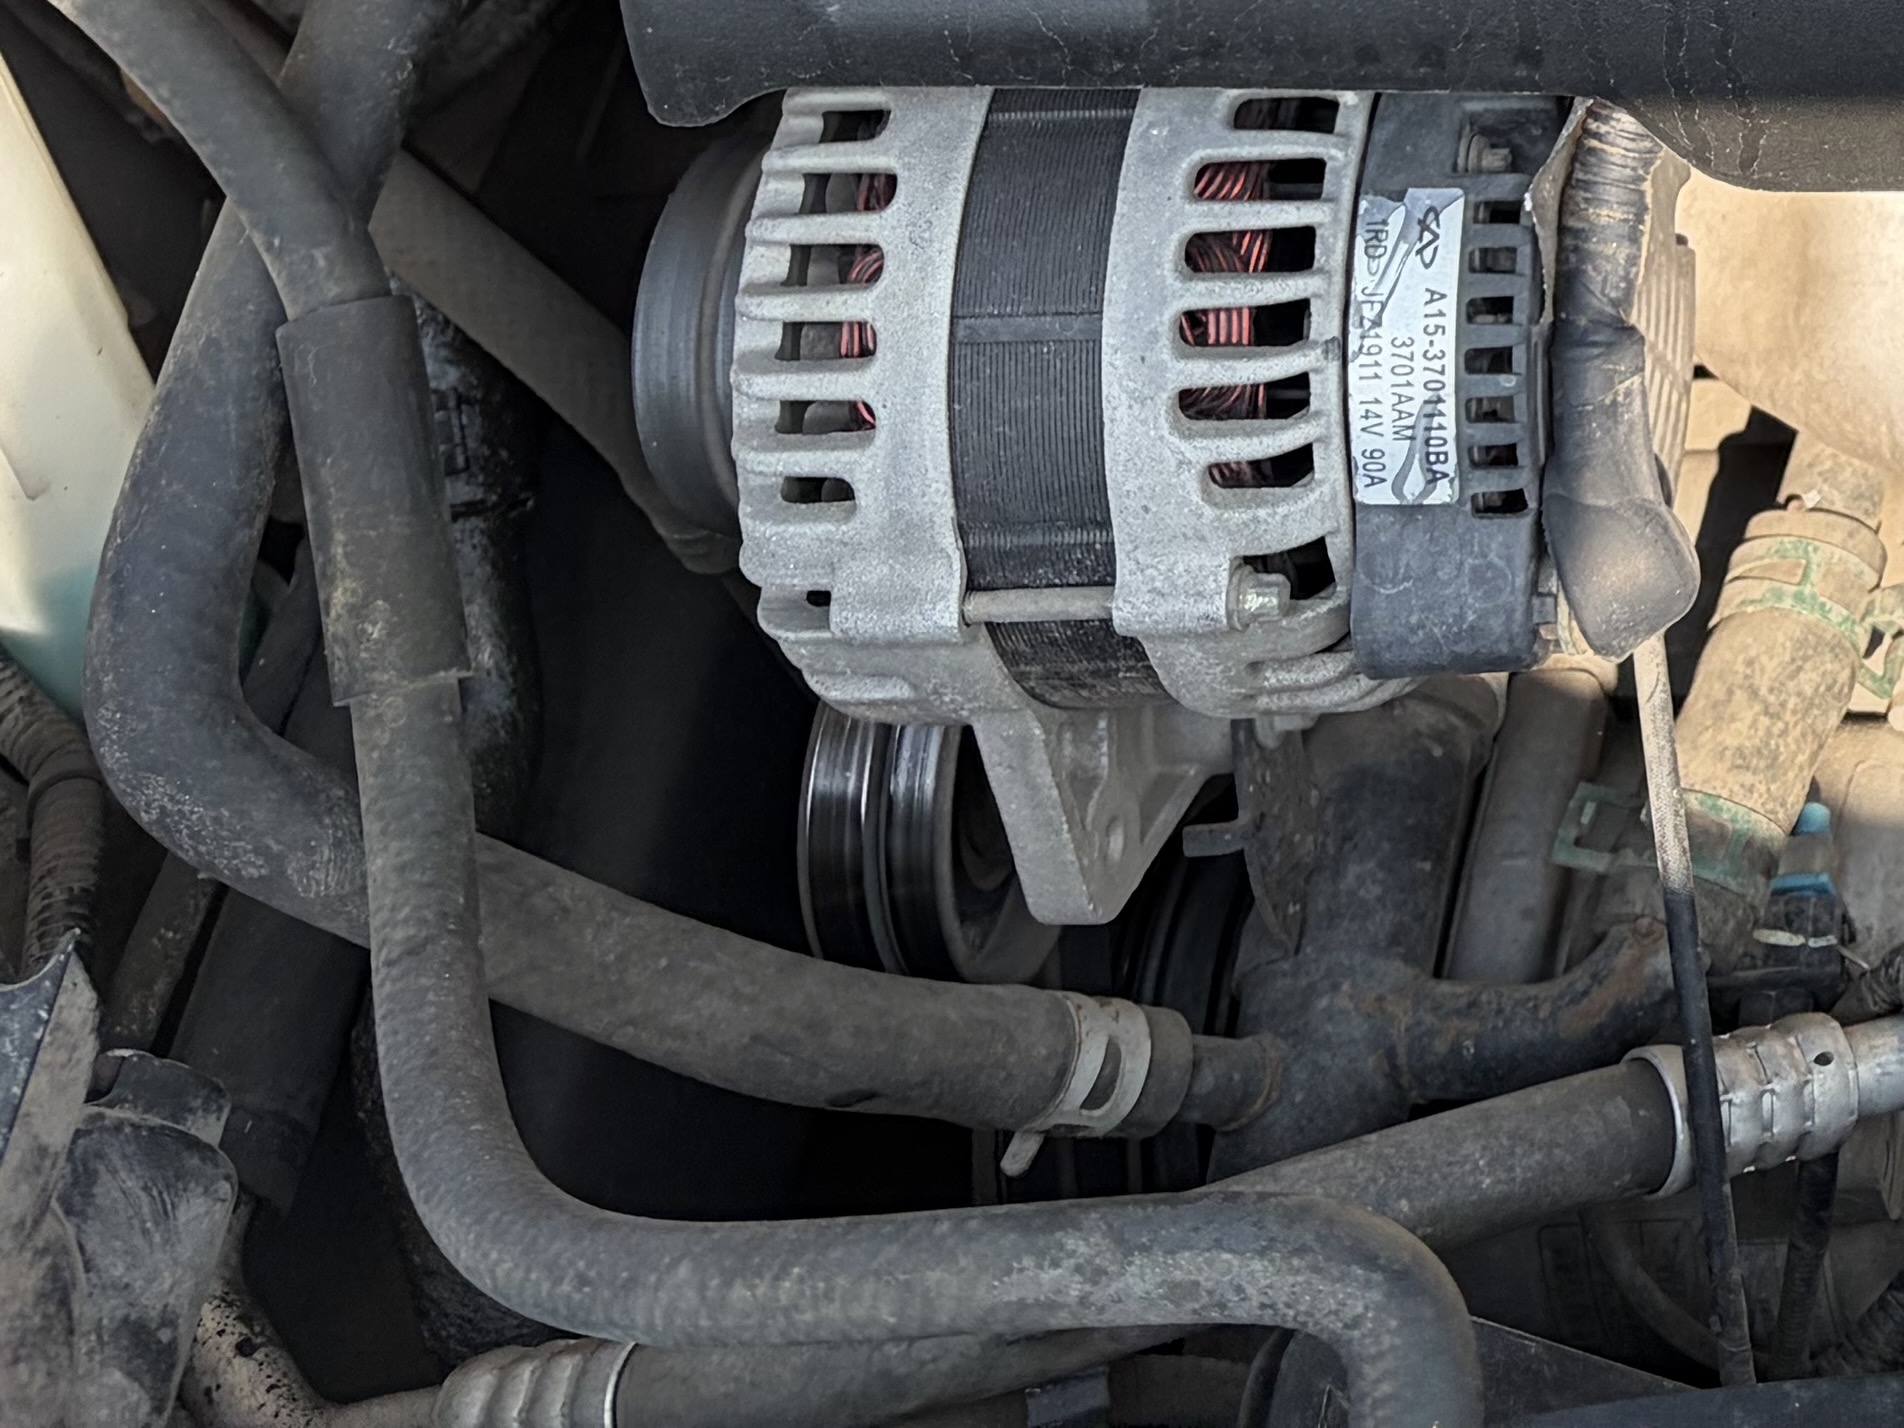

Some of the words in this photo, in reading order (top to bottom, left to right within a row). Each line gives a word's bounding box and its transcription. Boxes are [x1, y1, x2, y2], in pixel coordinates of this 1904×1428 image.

[1360, 397, 1384, 437] 14V
[1390, 336, 1416, 442] 3701AAM
[1422, 287, 1450, 485] A15-3701110BA
[1362, 448, 1388, 488] 90A
